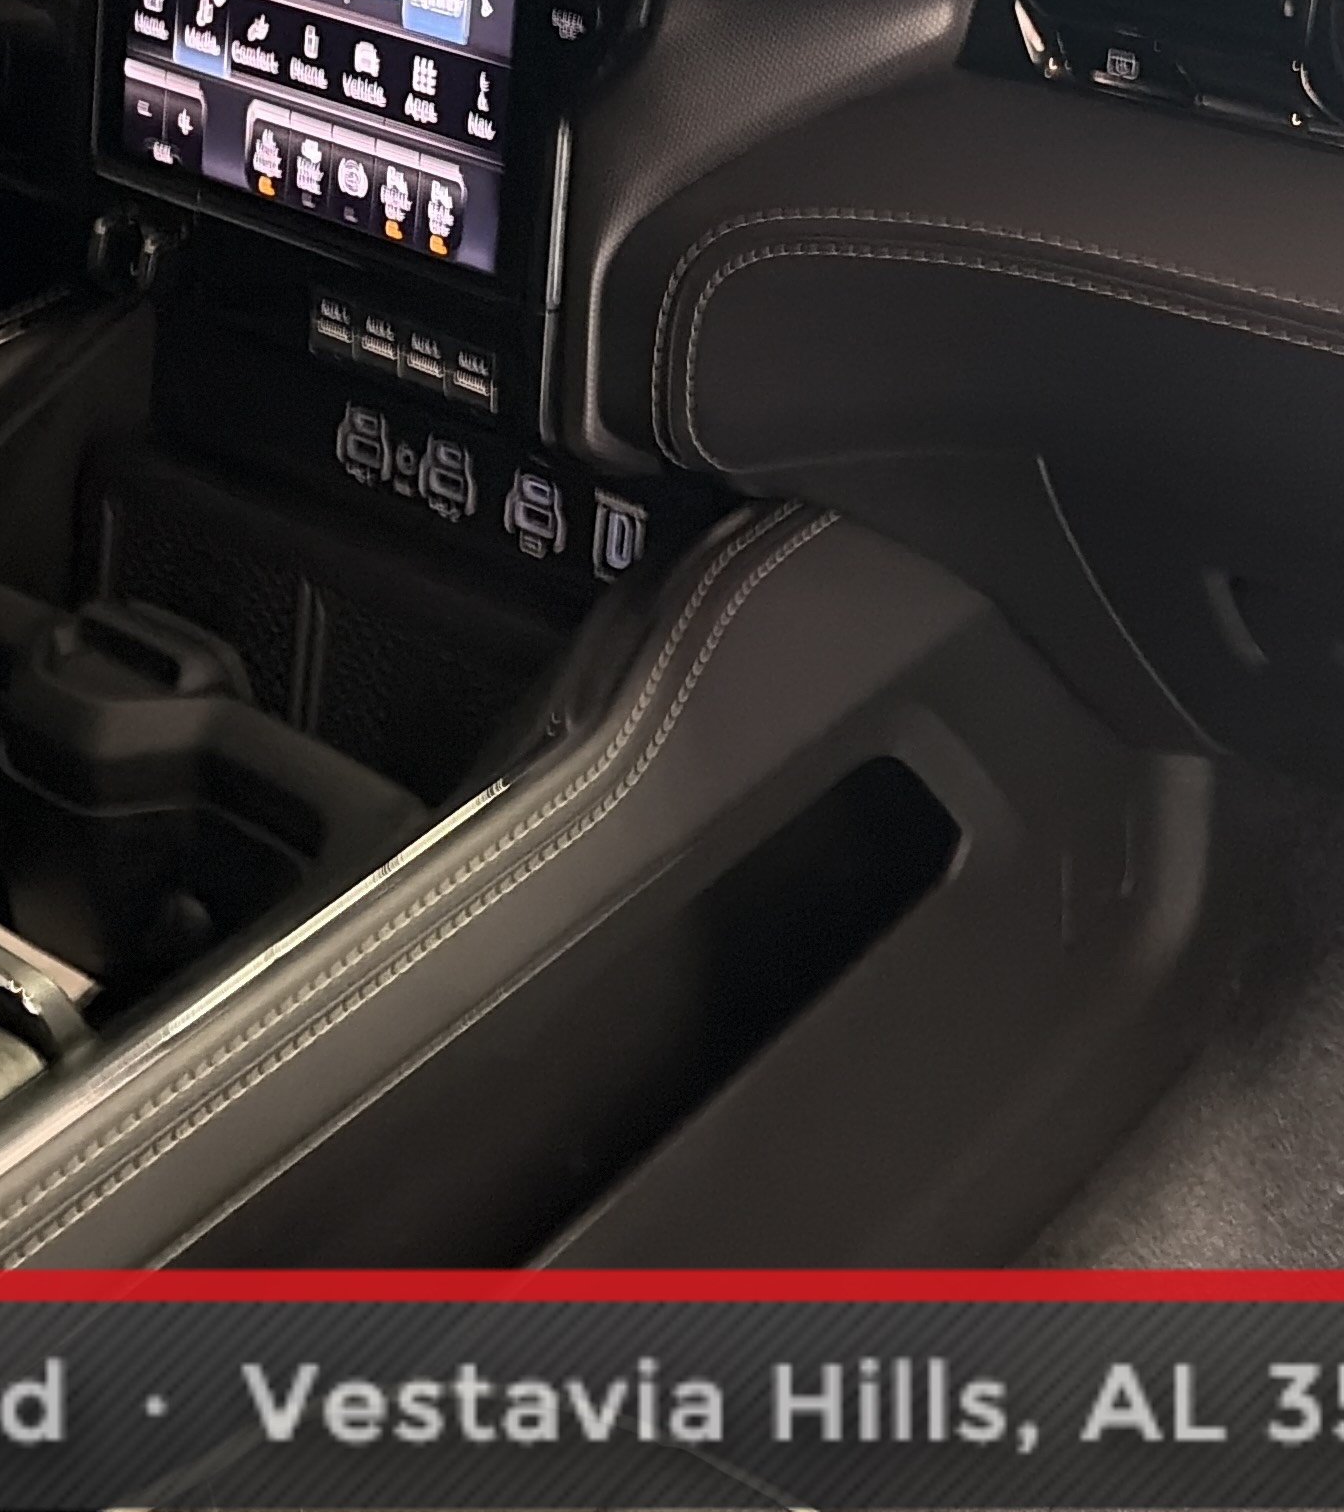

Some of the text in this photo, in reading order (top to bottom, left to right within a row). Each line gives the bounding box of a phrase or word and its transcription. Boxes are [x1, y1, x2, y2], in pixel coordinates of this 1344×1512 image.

[134, 9, 170, 41] Home
[184, 24, 221, 56] Media
[231, 39, 280, 75] Comfort
[289, 56, 329, 90] Phone
[342, 72, 387, 108] Vehicle
[405, 92, 438, 124] Apps
[467, 110, 497, 141] Nav
